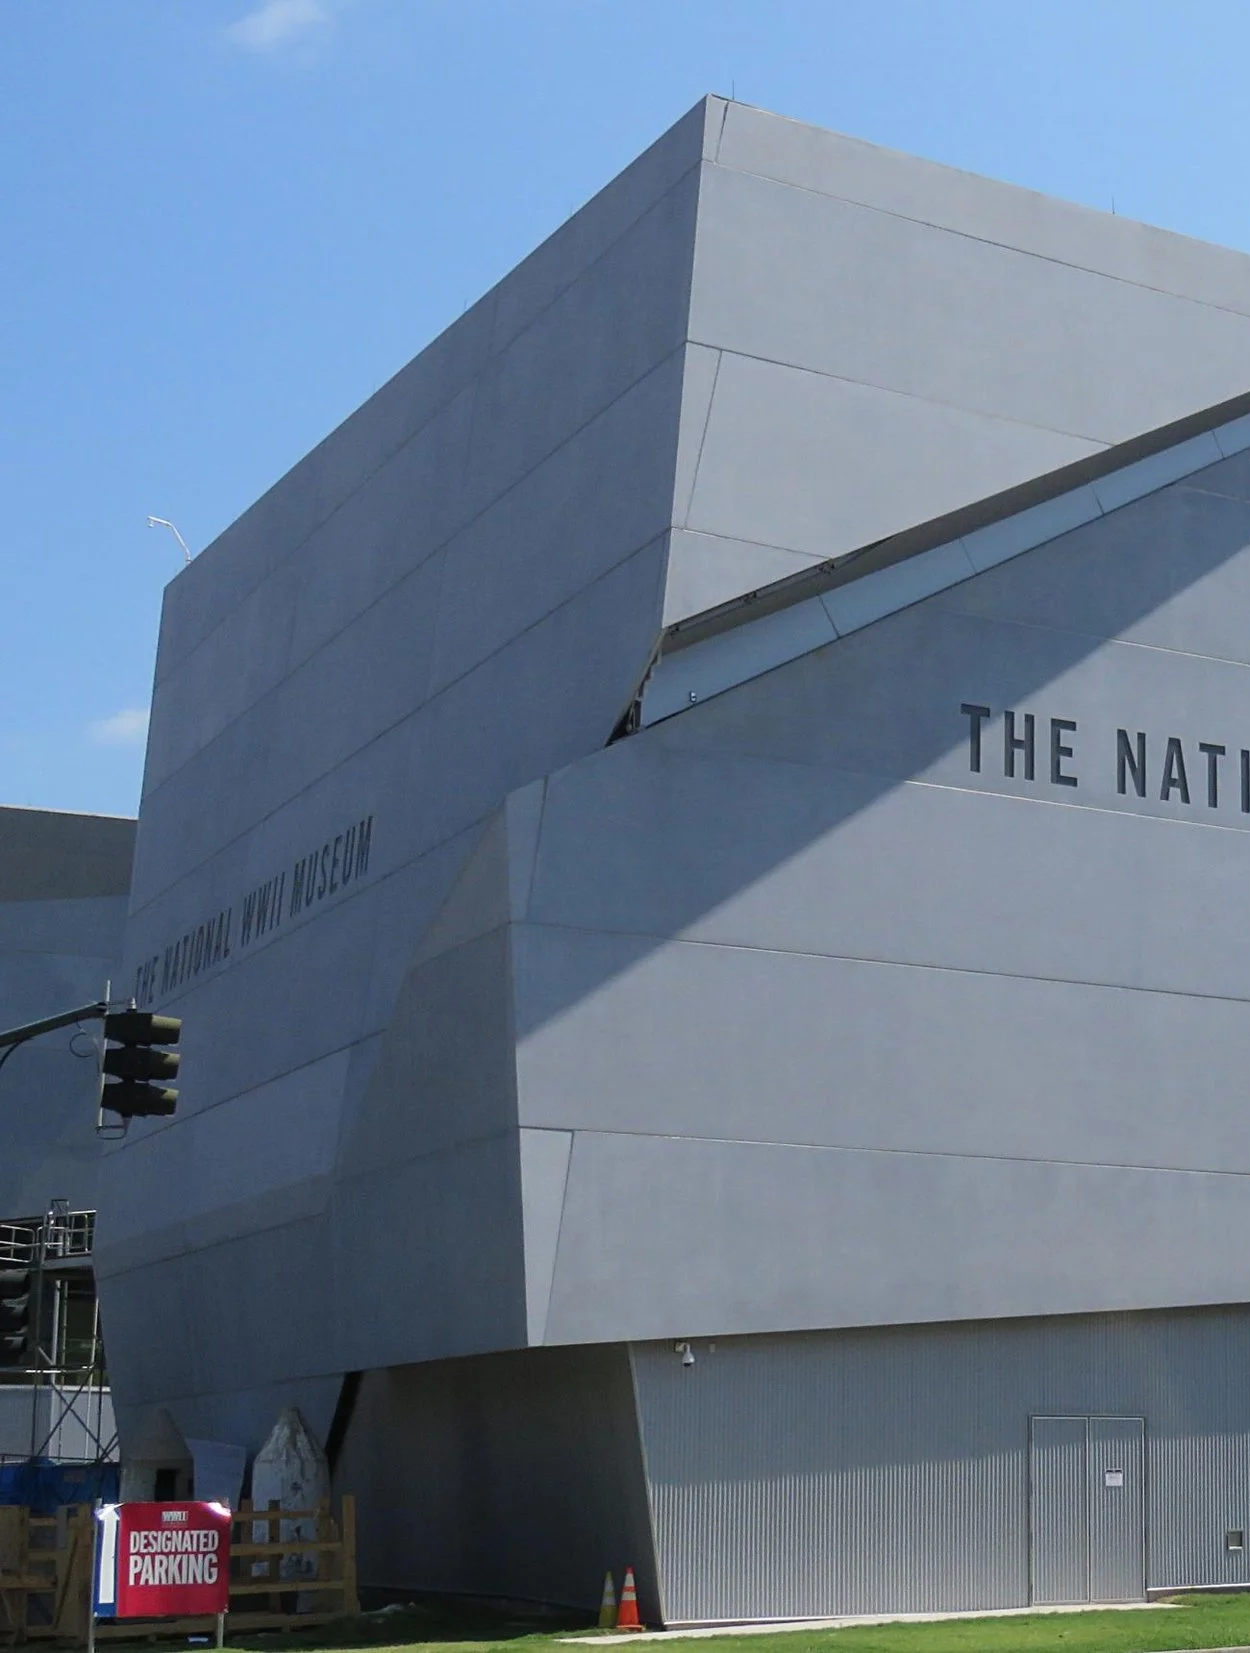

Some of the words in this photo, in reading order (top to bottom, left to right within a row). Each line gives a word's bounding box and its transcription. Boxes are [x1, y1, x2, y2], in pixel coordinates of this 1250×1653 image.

[960, 703, 1078, 787] THE
[135, 955, 159, 1008] THE
[162, 908, 232, 996] NATIONAL
[241, 872, 285, 946] WWII
[290, 816, 372, 917] MUSEUM
[129, 1555, 218, 1585] PARKING
[130, 1530, 219, 1553] DESIGNATED
